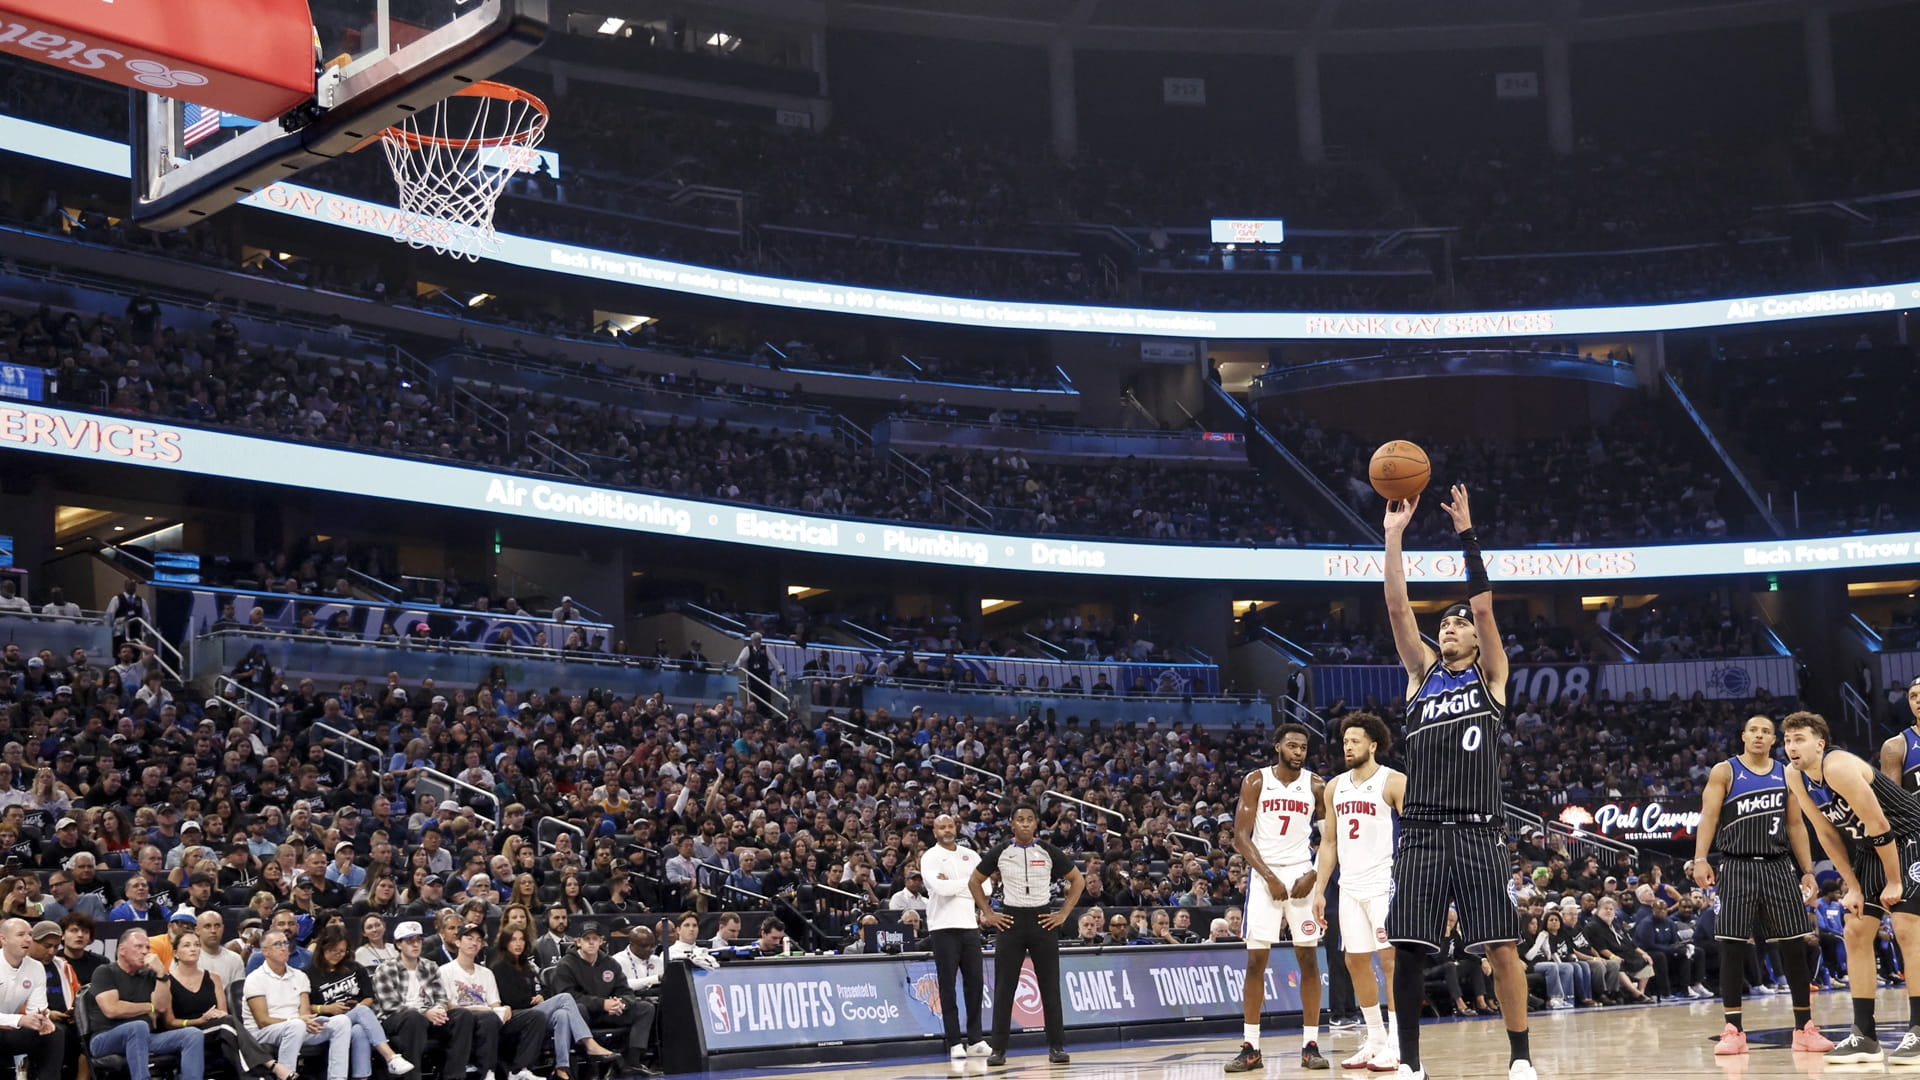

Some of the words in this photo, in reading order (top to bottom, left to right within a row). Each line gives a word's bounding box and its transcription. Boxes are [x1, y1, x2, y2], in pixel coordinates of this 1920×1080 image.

[0, 20, 124, 69] Stat
[264, 184, 323, 215] GAY
[327, 199, 450, 243] SERVICES
[550, 249, 589, 270] Each
[591, 255, 626, 275] Free
[626, 261, 677, 284] Throw
[1727, 301, 1760, 320] Air
[1762, 290, 1896, 317] Conditioning
[1306, 316, 1388, 335] FRANK
[1391, 316, 1440, 336] GAY
[1443, 314, 1554, 334] SERVICES
[486, 478, 527, 507] Air
[532, 485, 692, 534] Conditioning
[736, 512, 838, 547] Electrical
[883, 528, 989, 566] Plumbing
[1032, 542, 1105, 568] Drains
[1324, 554, 1425, 577] FRAK
[1499, 551, 1637, 576] SERVICES
[1743, 547, 1792, 566] Each
[1795, 545, 1840, 563] Free
[1842, 540, 1911, 560] Throw
[1511, 667, 1590, 709] 108
[1462, 725, 1482, 752] 0
[1262, 799, 1309, 816] PISTONS
[1336, 800, 1376, 817] PISTONS
[1594, 804, 1639, 834] Pal
[1278, 815, 1291, 836] 7
[1349, 818, 1360, 840] 2
[1625, 831, 1672, 841] RESTAURANT
[1768, 816, 1780, 835] 3
[1065, 967, 1121, 1012] GAME
[1122, 970, 1136, 1009] 4
[1150, 965, 1225, 1007] TONIGHT
[1223, 964, 1247, 1003] 6P
[730, 981, 836, 1033] PLAYOFFS
[841, 1000, 900, 1025] Google
